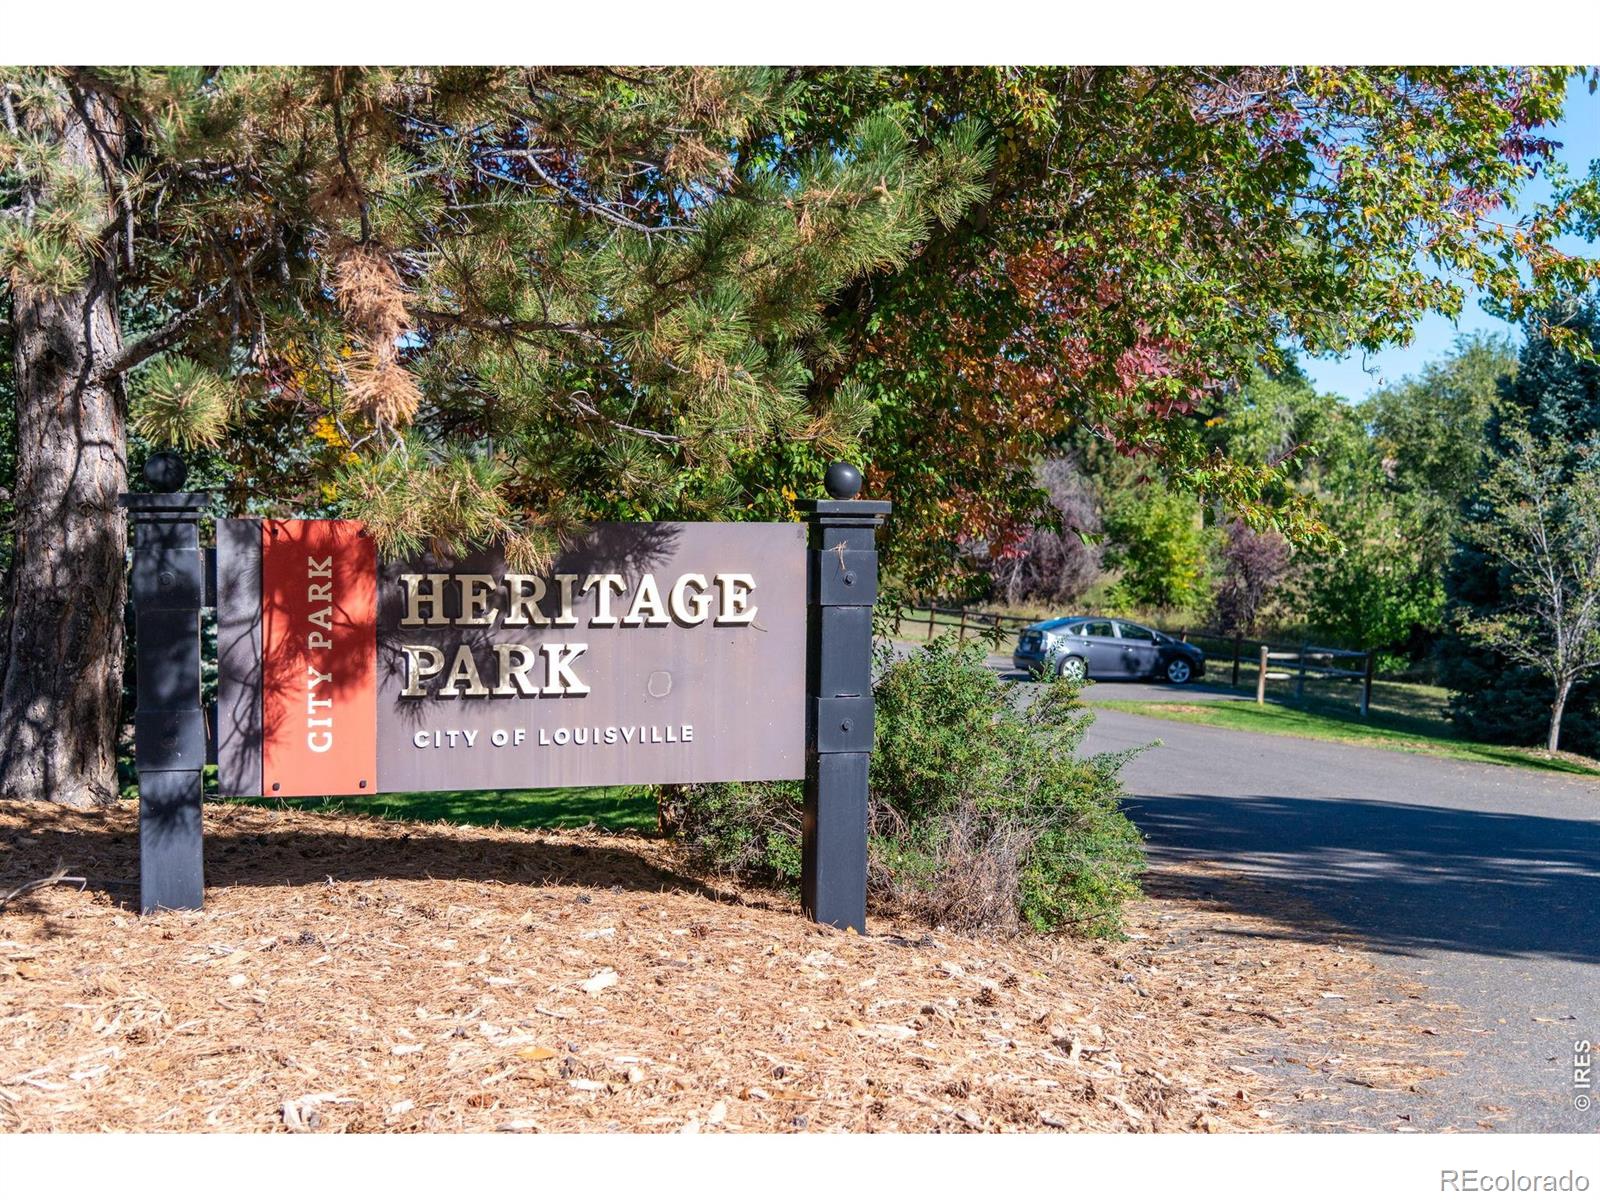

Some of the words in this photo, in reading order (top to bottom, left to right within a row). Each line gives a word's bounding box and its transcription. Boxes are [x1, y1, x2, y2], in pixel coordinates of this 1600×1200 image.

[307, 554, 333, 650] PARK
[400, 572, 758, 627] HERITAGE
[400, 643, 591, 699] PARK
[307, 667, 333, 753] CITY
[413, 728, 480, 749] CITY
[491, 728, 526, 747] OF
[538, 725, 694, 746] LOUISVILLE
